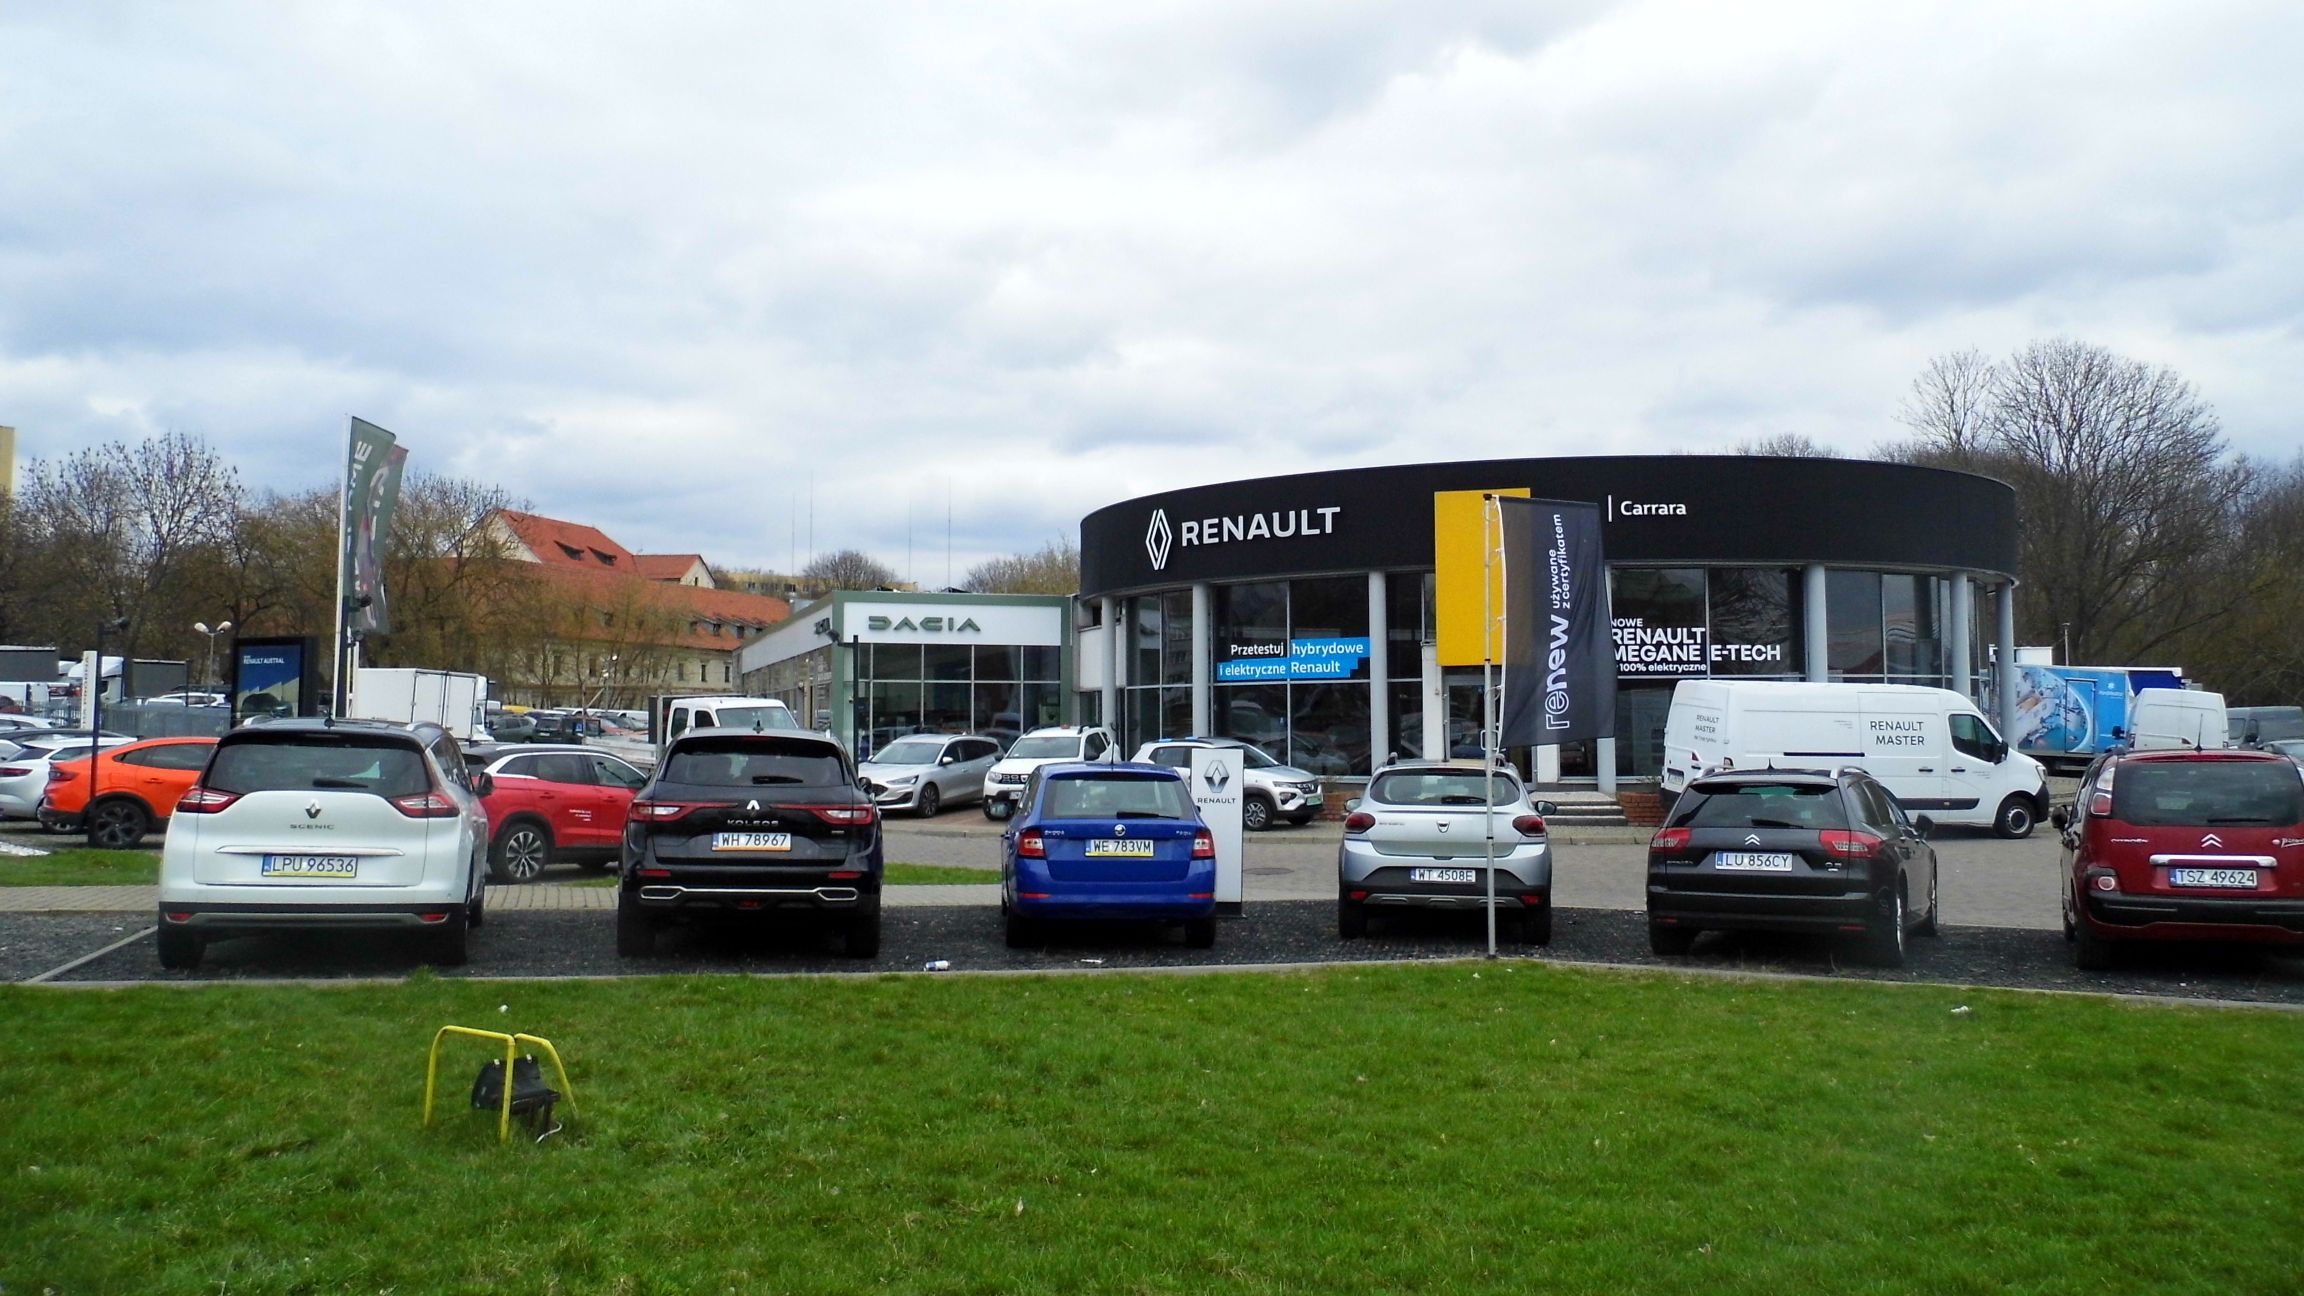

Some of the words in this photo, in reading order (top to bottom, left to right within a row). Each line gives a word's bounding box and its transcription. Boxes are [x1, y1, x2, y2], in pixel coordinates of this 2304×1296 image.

[1620, 500, 1687, 516] Carrara
[1181, 506, 1341, 547] RENAULT
[1553, 514, 1570, 599] certyfikatem
[1548, 549, 1562, 609] używane
[1562, 601, 1571, 609] z
[868, 615, 981, 632] DACIA
[1611, 618, 1643, 627] NOWE
[1612, 627, 1706, 645] RENAULT
[1230, 642, 1284, 656] Przetestuj
[1292, 642, 1364, 657] hybrydowe
[1614, 645, 1701, 662] MEGANE
[1711, 644, 1781, 661] E-TECH
[1219, 664, 1223, 676] i
[1225, 664, 1286, 678] elektryczne
[1291, 660, 1341, 673] Renault
[1545, 614, 1570, 730] renew
[1619, 663, 1647, 672] 100%
[1648, 663, 1707, 674] elektryczne
[1696, 714, 1720, 724] RENAULT
[1869, 720, 1924, 731] RENAULT
[1695, 725, 1716, 733] MASTER
[1875, 735, 1925, 746] MASTER
[727, 819, 779, 827] KOLEOS
[722, 833, 740, 846] WH
[745, 833, 787, 847] 78967
[1094, 840, 1110, 853] WE
[1115, 840, 1151, 853] 783VM
[272, 857, 303, 872] LPU
[307, 858, 354, 873] 96536
[1725, 854, 1743, 866] LU
[1748, 854, 1789, 867] 856CY
[1418, 869, 1432, 880] WT
[1437, 869, 1473, 882] 4508E
[2177, 870, 2206, 883] TSZ
[2211, 871, 2255, 884] 49624
